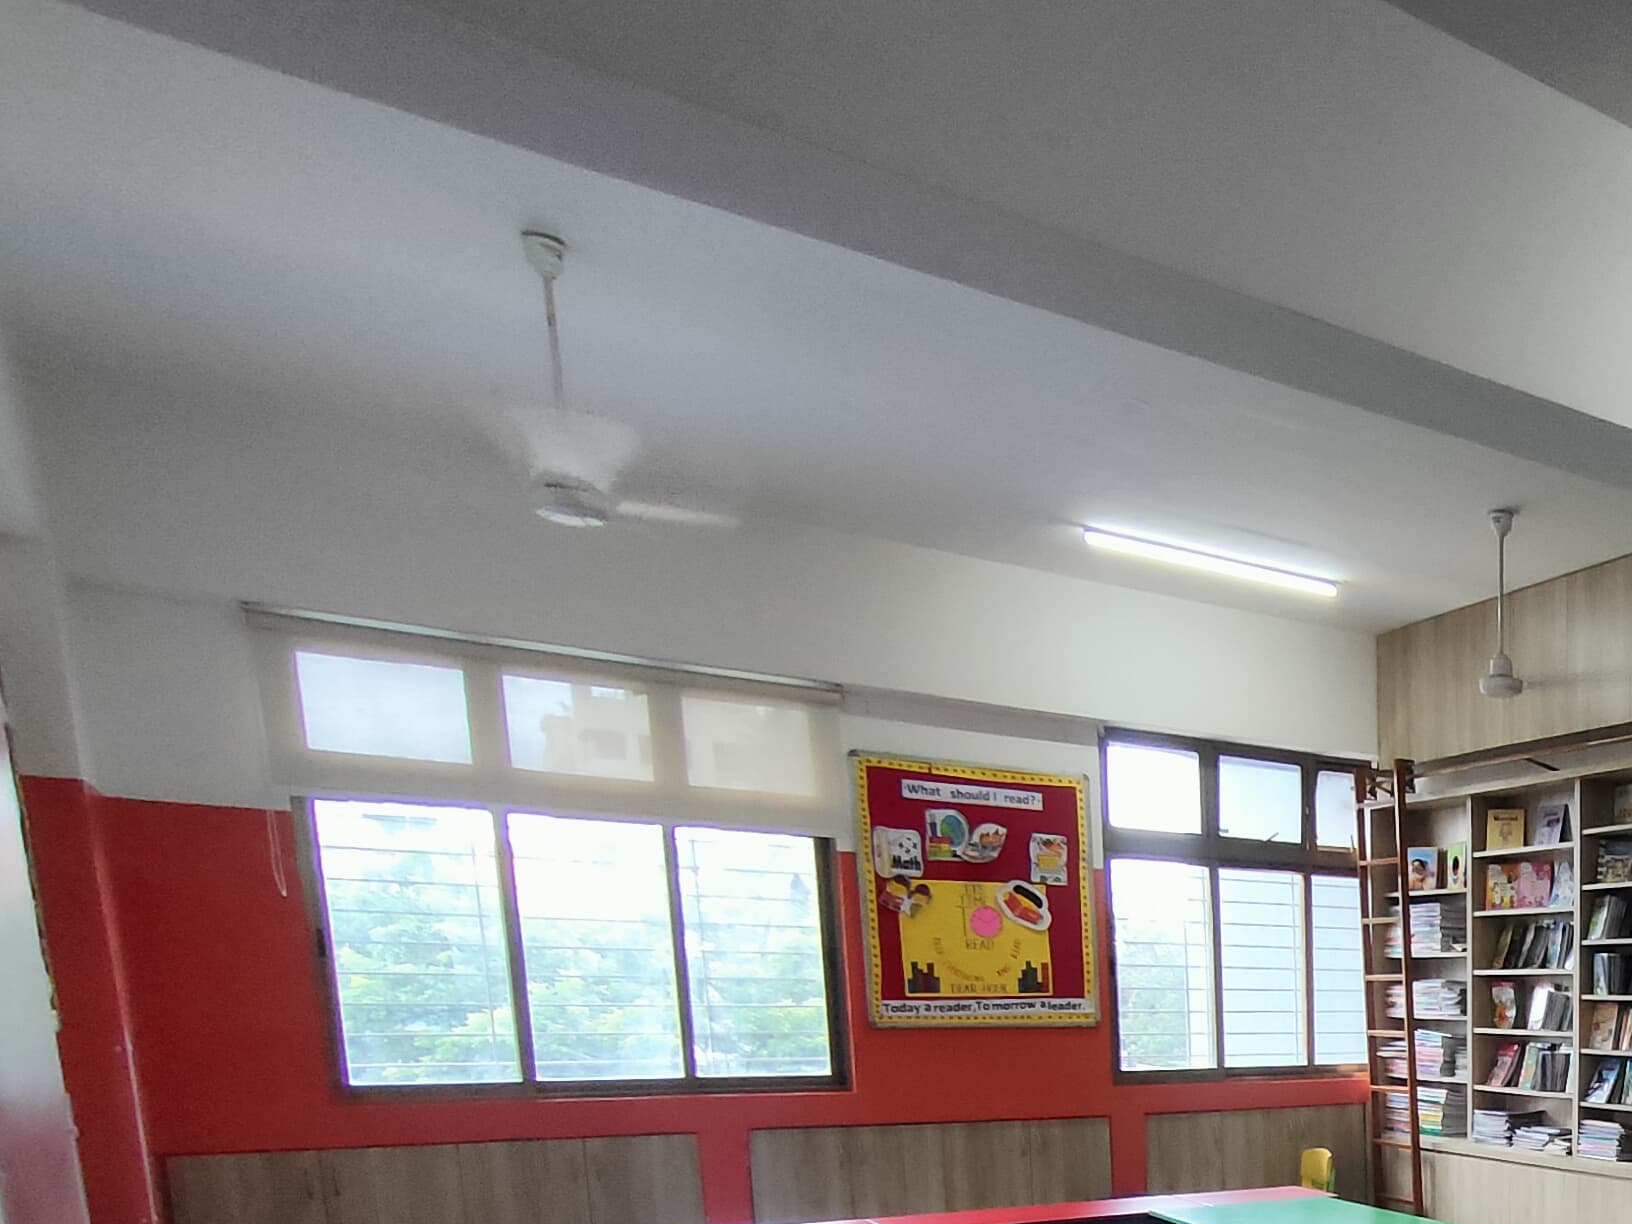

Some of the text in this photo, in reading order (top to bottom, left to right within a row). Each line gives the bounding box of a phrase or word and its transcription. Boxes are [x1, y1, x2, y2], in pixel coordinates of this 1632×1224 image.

[905, 783, 941, 797] What
[949, 788, 990, 801] should
[1003, 793, 1036, 805] read?
[882, 1003, 920, 1015] Today
